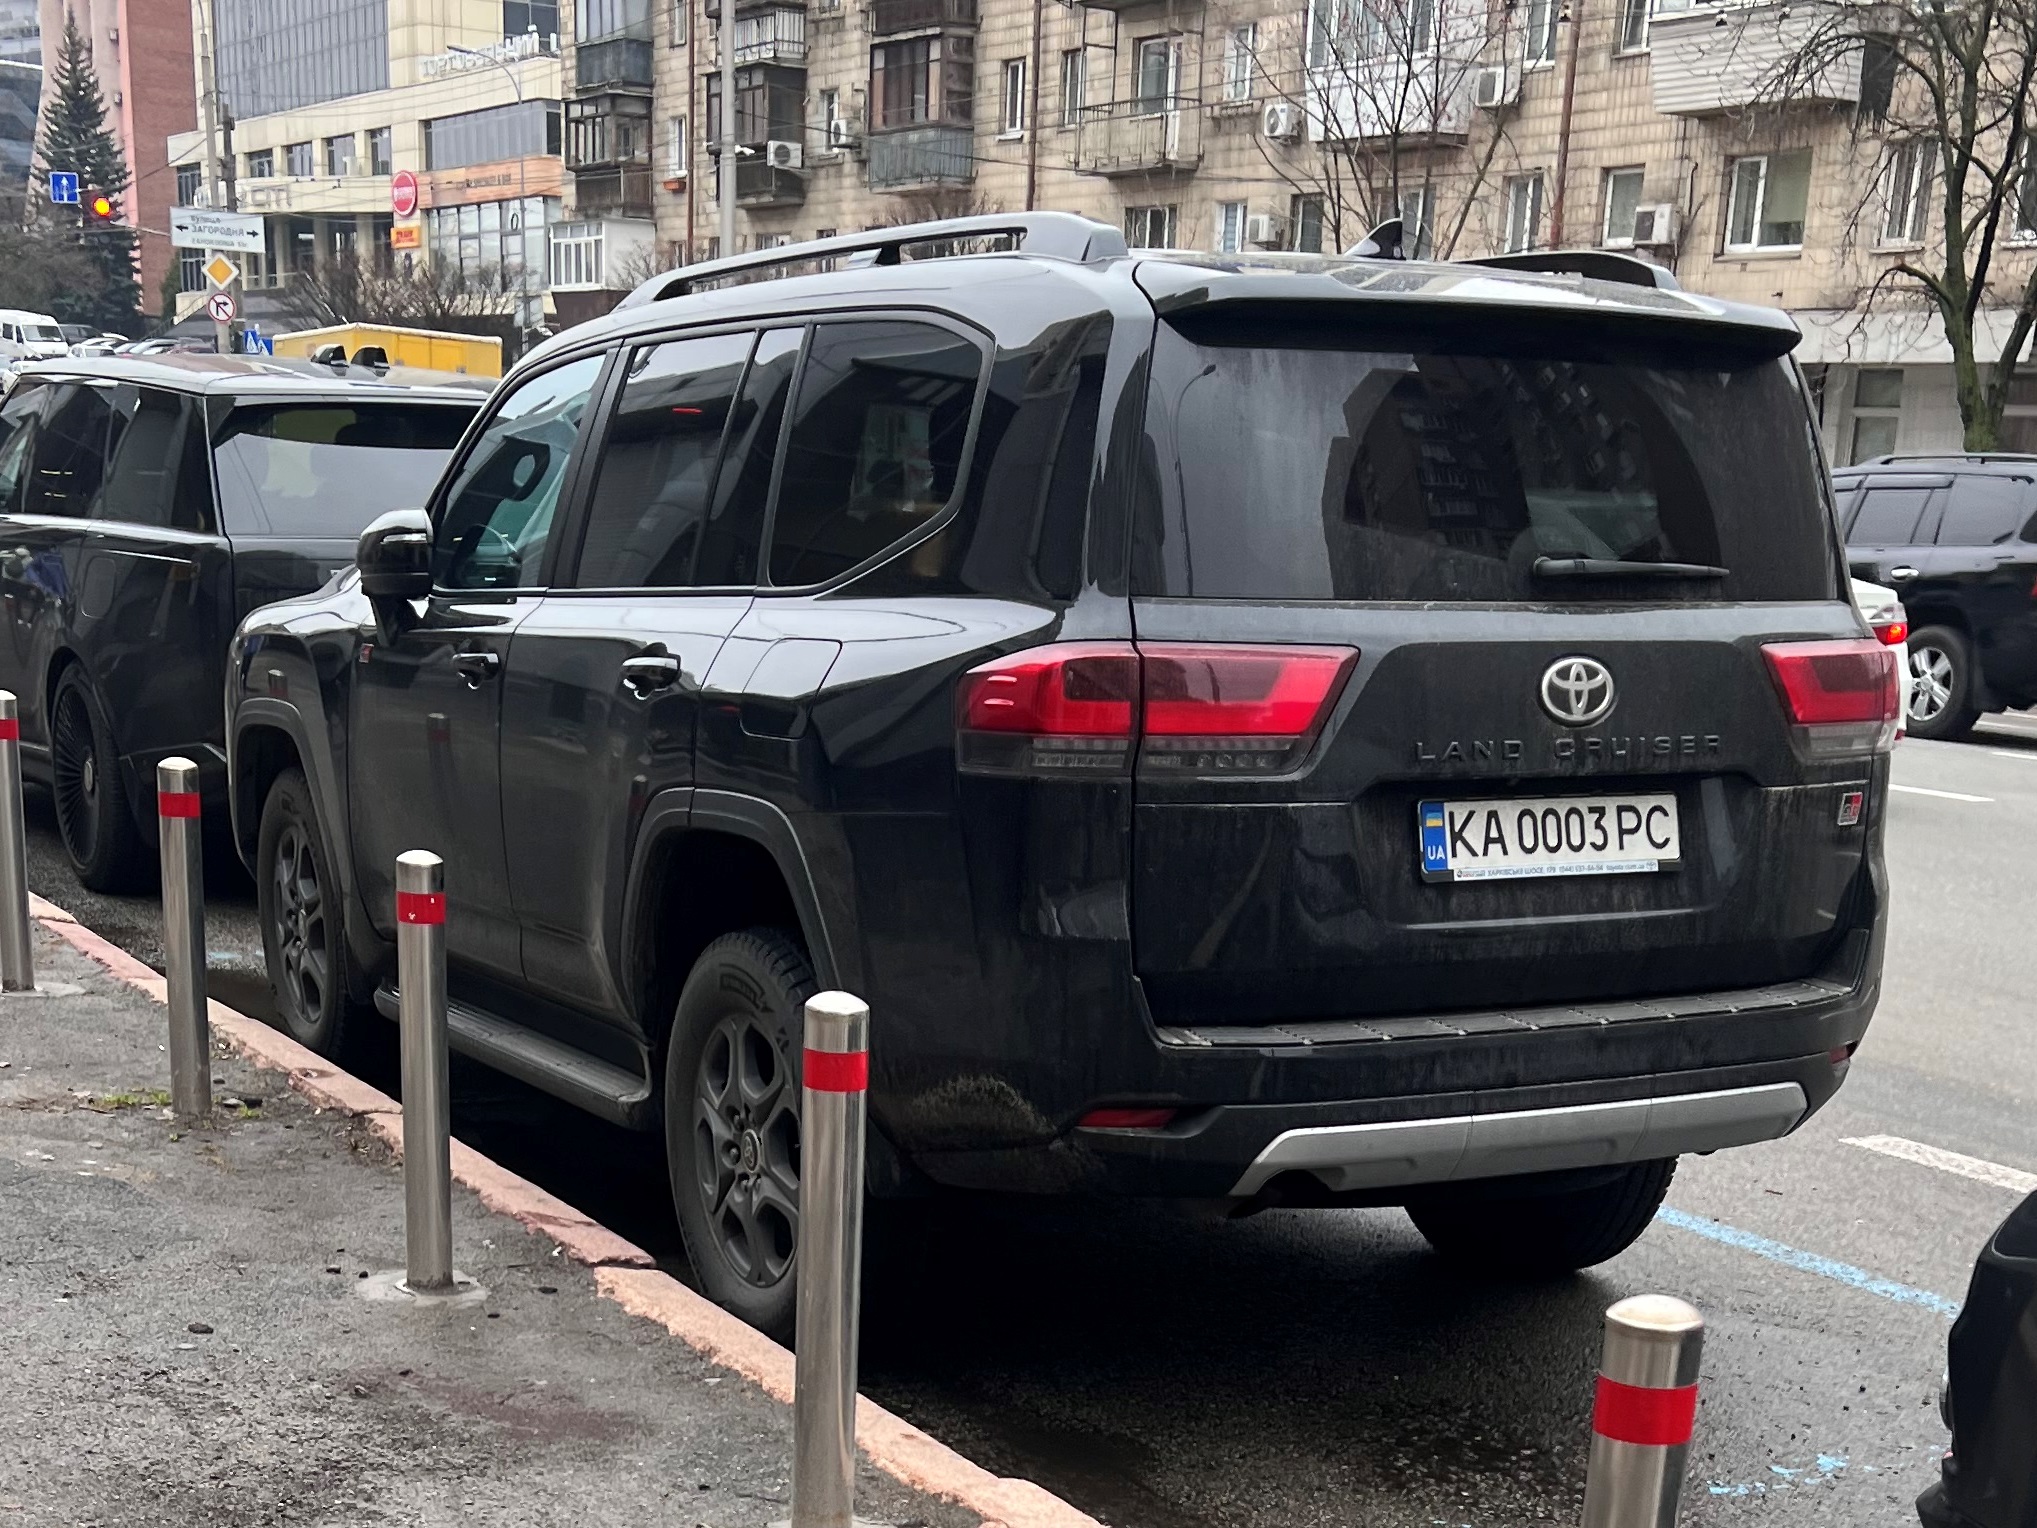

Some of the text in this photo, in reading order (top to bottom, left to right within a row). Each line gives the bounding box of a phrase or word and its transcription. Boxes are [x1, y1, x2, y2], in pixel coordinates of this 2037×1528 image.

[1416, 735, 1721, 760] LAND CRUISER
[1427, 845, 1446, 861] UA
